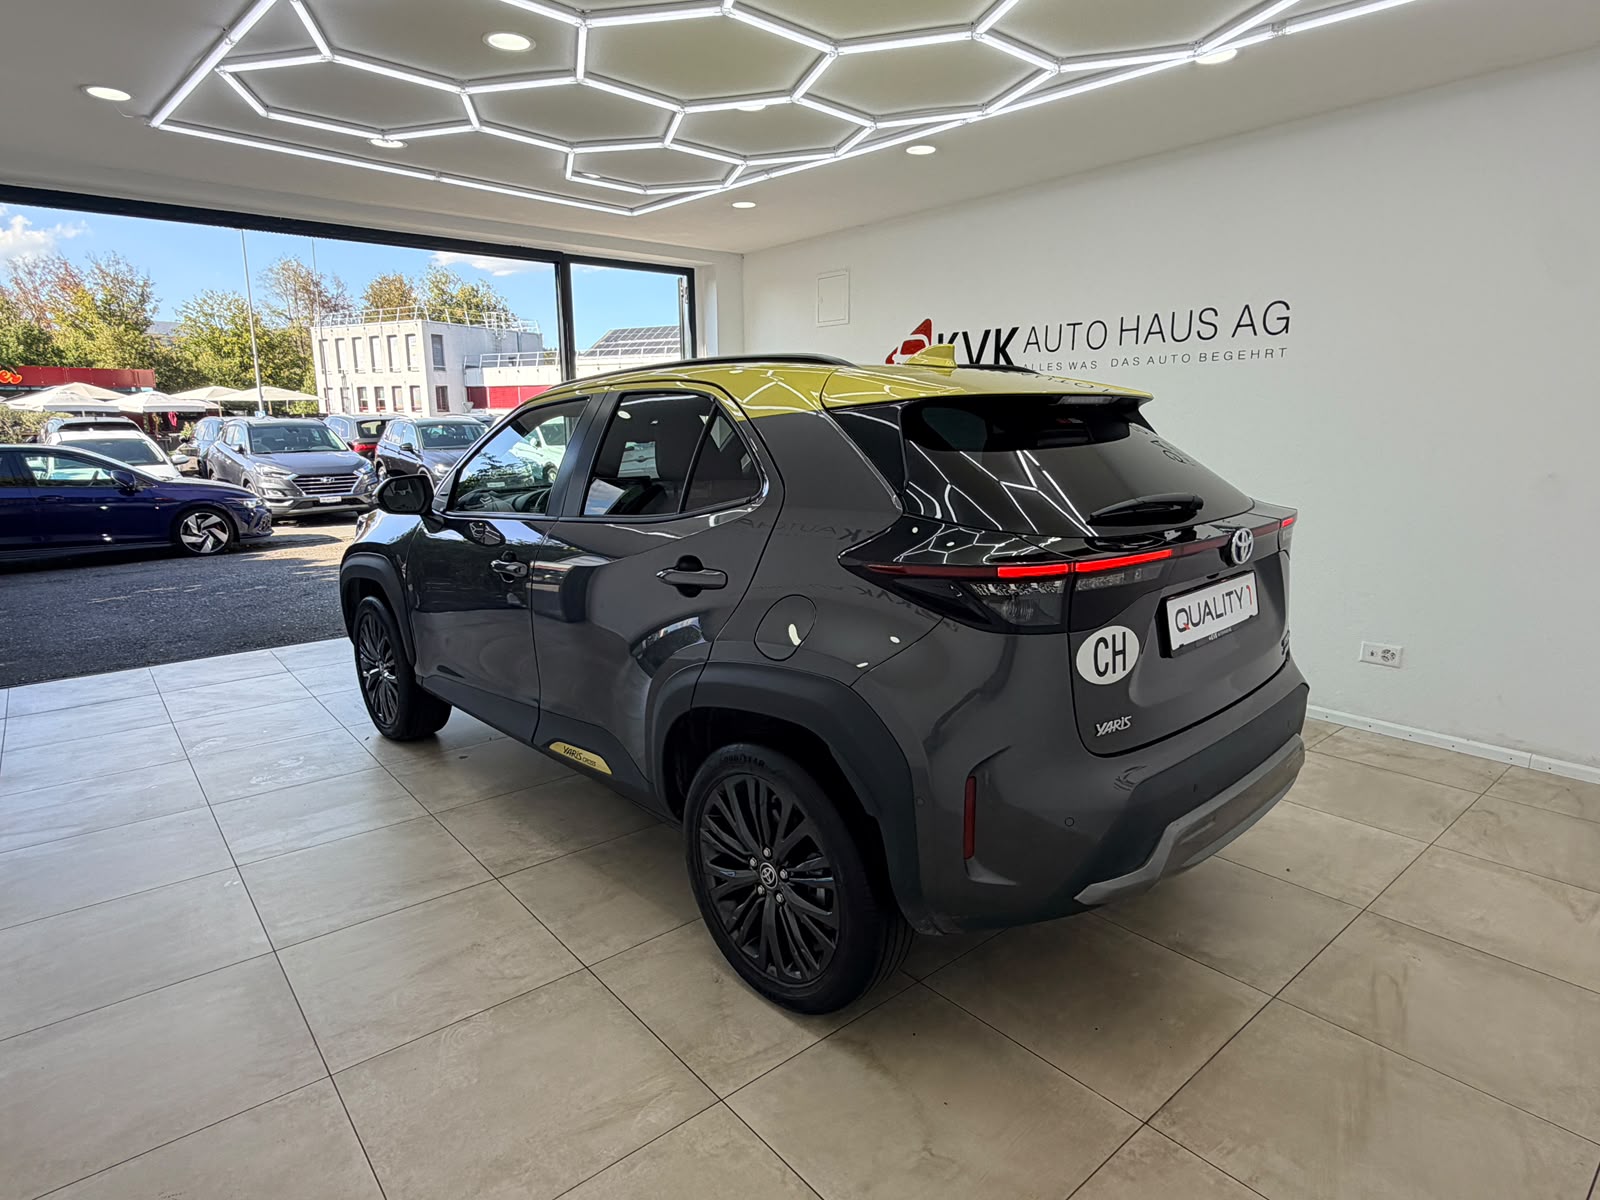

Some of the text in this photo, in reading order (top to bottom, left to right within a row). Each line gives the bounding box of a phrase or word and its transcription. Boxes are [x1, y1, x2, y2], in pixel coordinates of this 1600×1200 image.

[1023, 319, 1108, 354] AUTO
[1118, 307, 1219, 346] HAUS
[1231, 300, 1291, 338] AG
[1068, 360, 1098, 370] WAS
[1110, 356, 1140, 368] DAS
[1147, 353, 1191, 365] AUTO
[1199, 347, 1288, 362] BEGEHRT
[1093, 631, 1127, 678] CH
[1096, 716, 1132, 736] YARIS
[563, 745, 583, 760] YARIS
